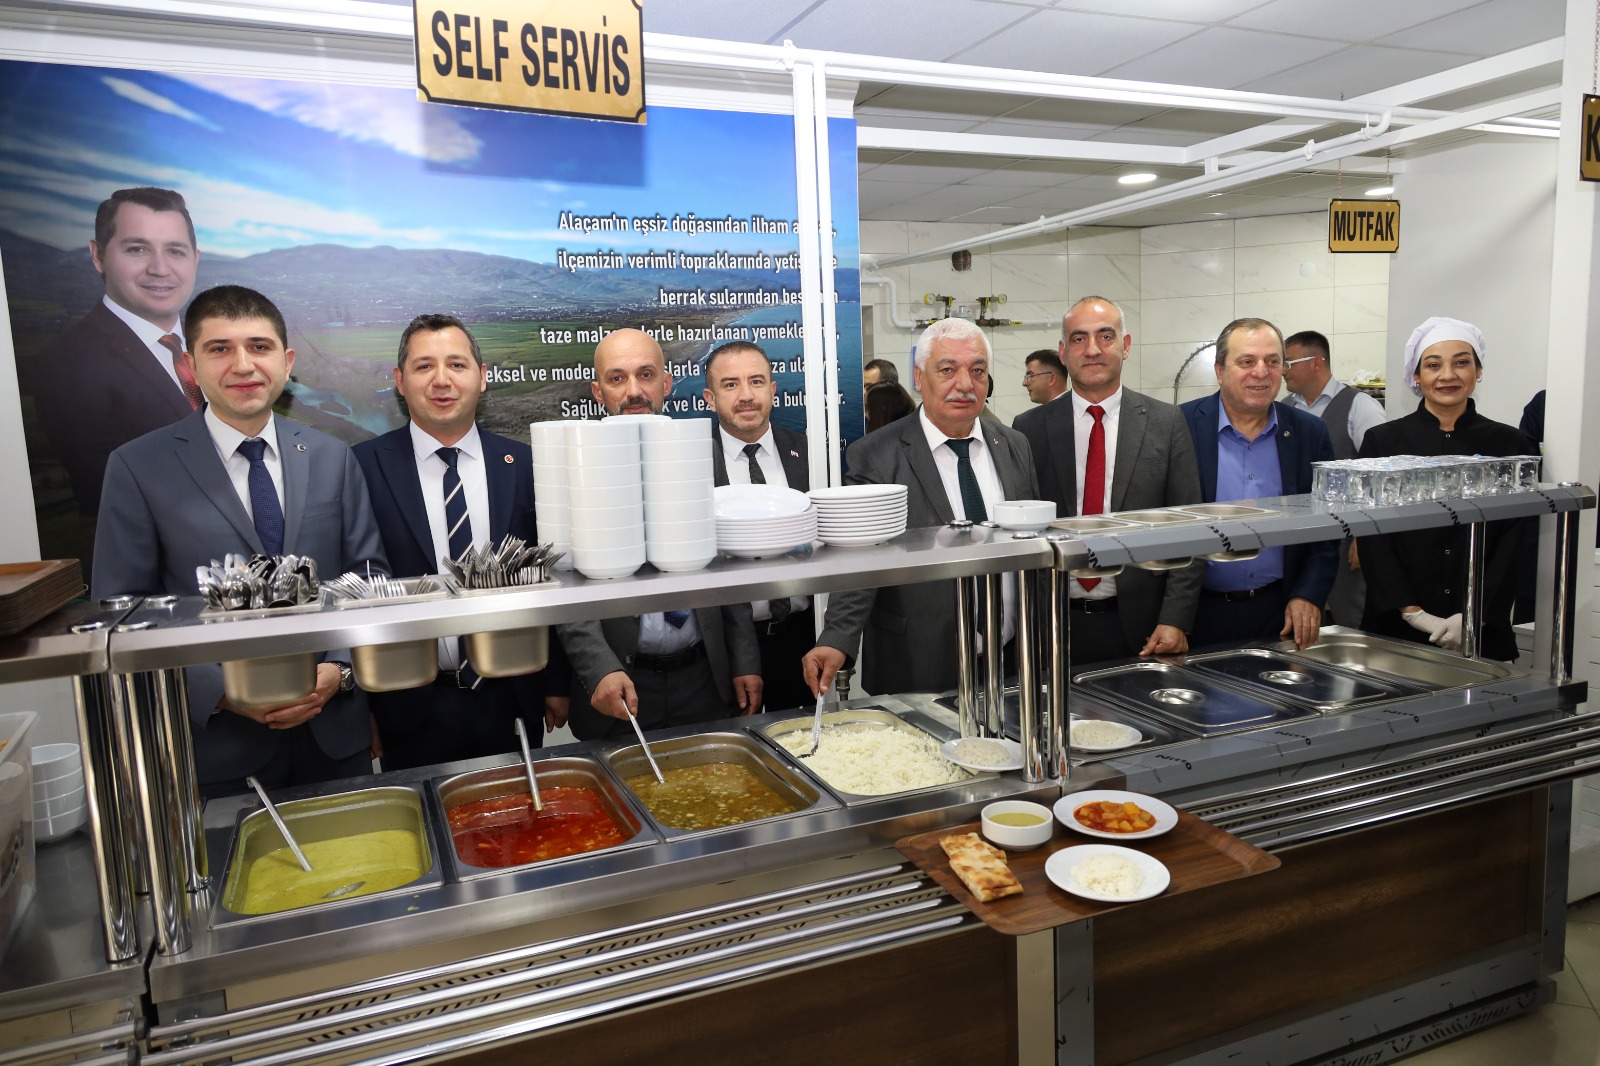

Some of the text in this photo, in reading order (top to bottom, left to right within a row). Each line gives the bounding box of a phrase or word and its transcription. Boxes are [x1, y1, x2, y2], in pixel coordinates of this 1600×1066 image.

[431, 10, 630, 96] SELF SERVİS
[559, 212, 629, 236] Alaçam'ın
[633, 214, 669, 237] eşsiz
[672, 214, 749, 237] doğasından
[752, 217, 789, 234] ilham
[1333, 210, 1396, 242] MUTFAK
[558, 250, 624, 273] ilçemizin
[627, 251, 677, 269] verimli
[680, 252, 771, 273] topraklarında
[660, 288, 706, 305] berrak
[709, 288, 779, 305] sularından
[540, 327, 572, 344] taze
[678, 322, 749, 341] hazırlanan
[530, 368, 547, 381] ve
[673, 400, 689, 412] ve
